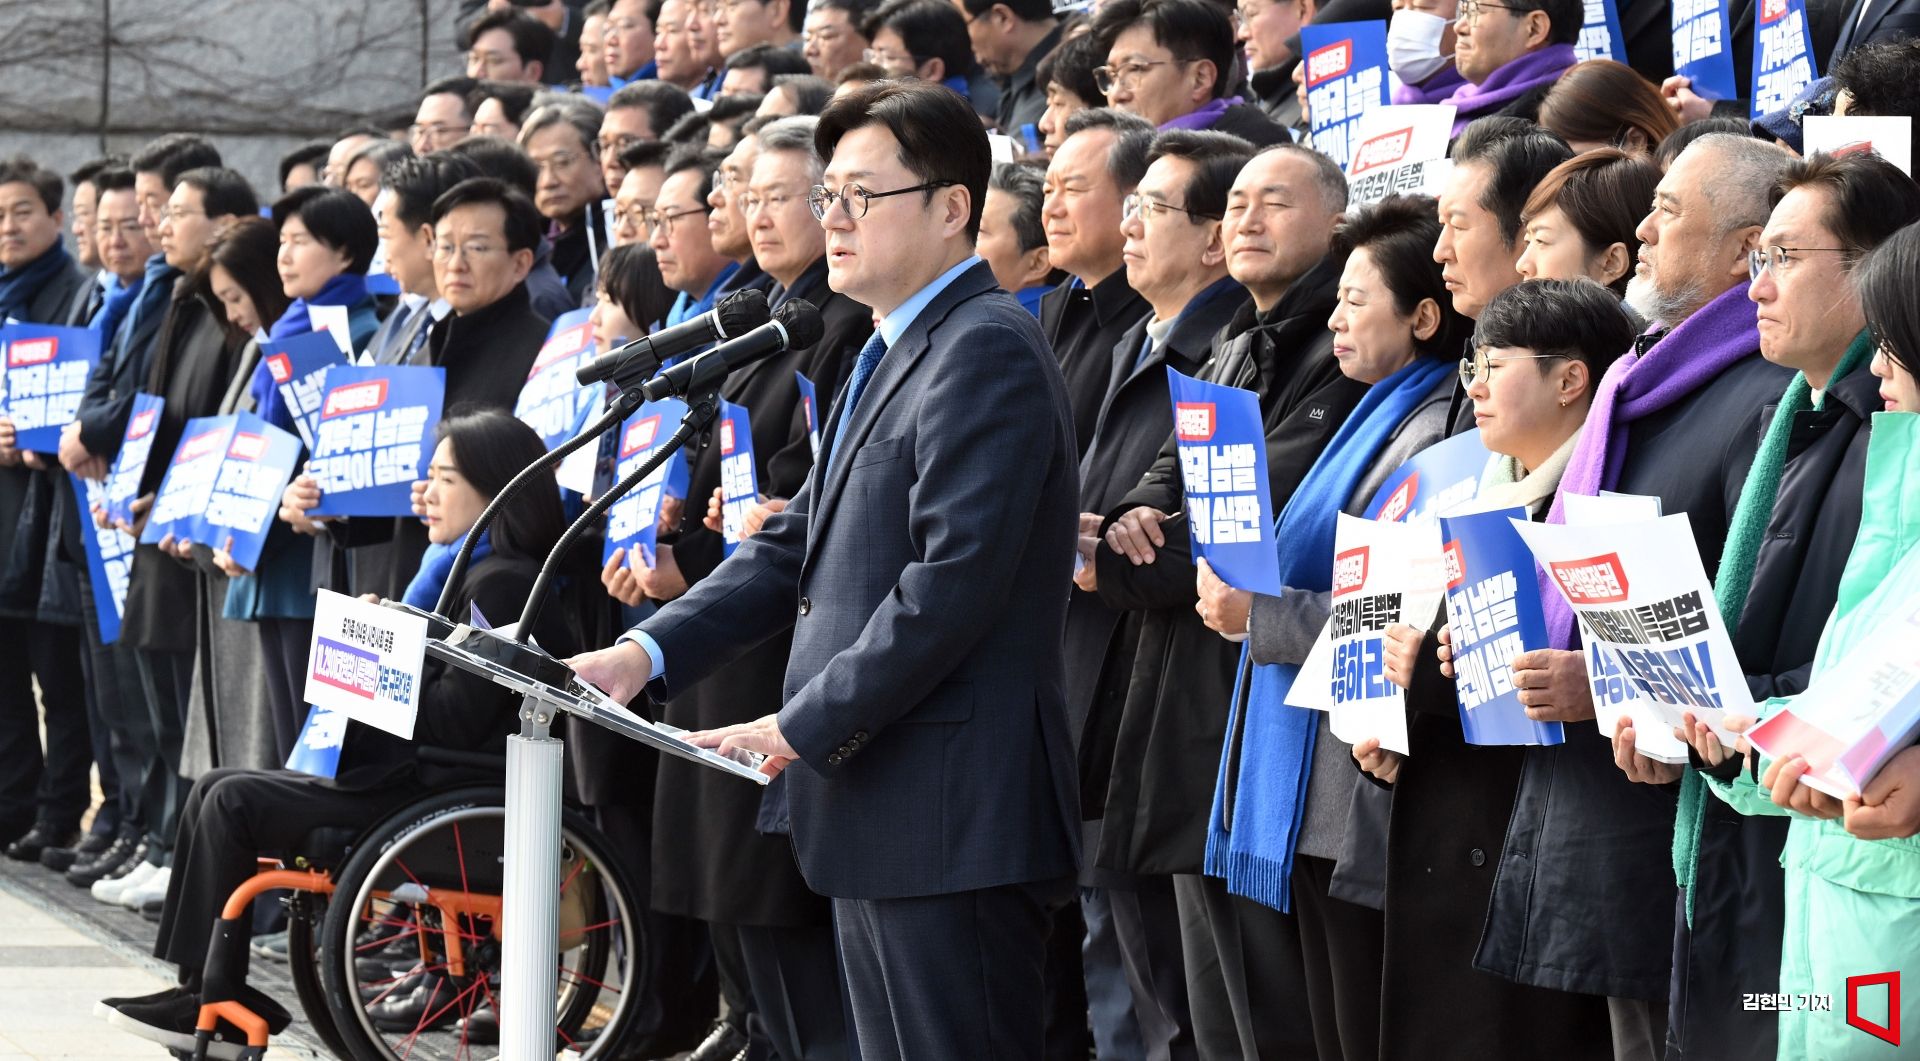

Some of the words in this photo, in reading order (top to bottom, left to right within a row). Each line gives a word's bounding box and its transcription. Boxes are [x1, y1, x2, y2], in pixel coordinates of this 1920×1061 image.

[1691, 11, 1721, 61] 심판
[375, 405, 429, 447] 남발
[374, 443, 422, 486] 심판
[1210, 443, 1257, 493] 남발
[1212, 495, 1262, 544] 심판
[1467, 571, 1518, 639] 남발
[1555, 563, 1624, 598] 윤석열정권
[1580, 590, 1710, 644] 이태원참사특별법
[1615, 640, 1723, 709] 수용하라!
